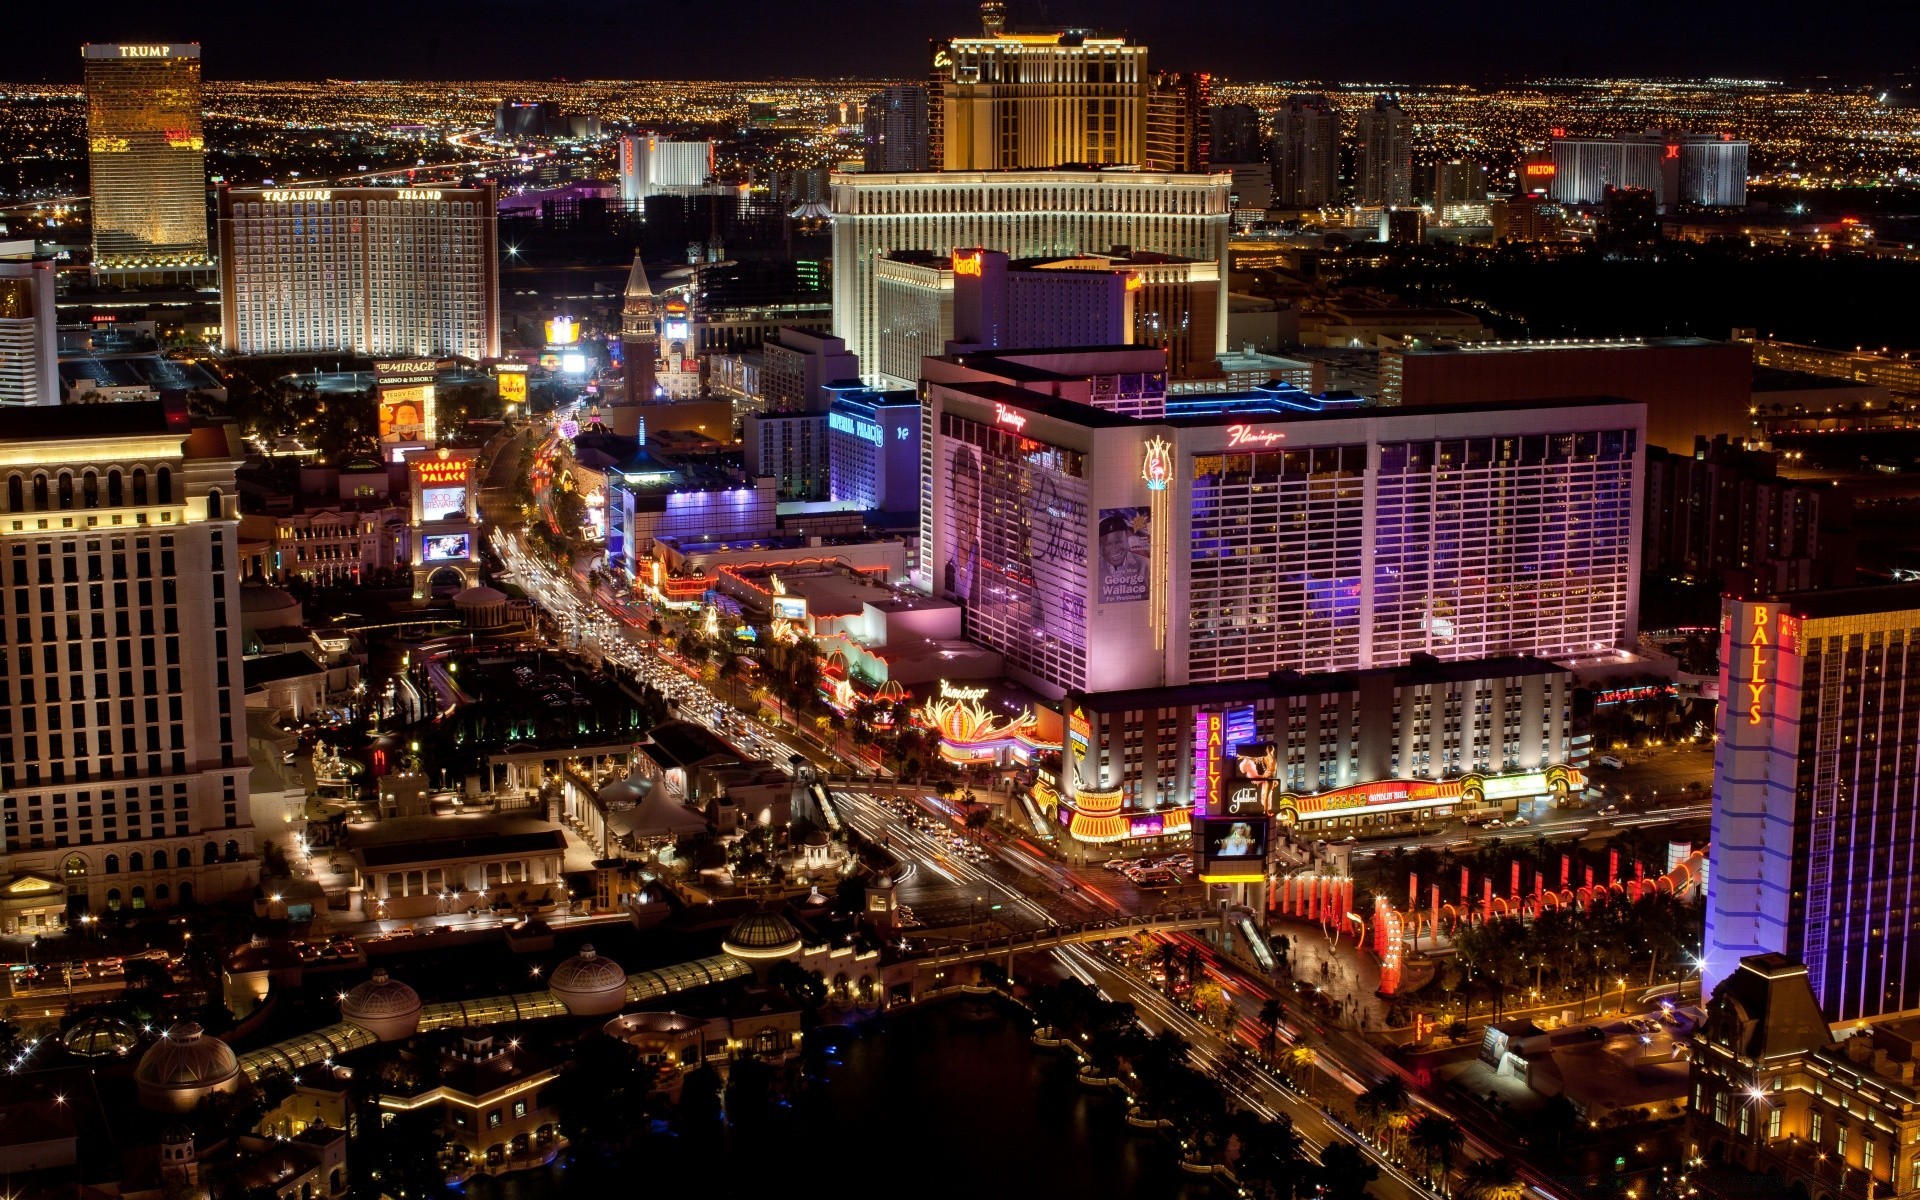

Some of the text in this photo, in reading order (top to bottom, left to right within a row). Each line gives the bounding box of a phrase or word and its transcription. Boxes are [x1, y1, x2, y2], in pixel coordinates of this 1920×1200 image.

[119, 46, 170, 57] TRUMP
[1527, 165, 1555, 175] HILTON
[262, 190, 442, 201] TREASURE ISLAND
[389, 361, 435, 373] MIRAGE
[995, 403, 1027, 432] Flamingo
[829, 412, 854, 435] IMPERIAL
[1226, 424, 1285, 447] Flamingo
[419, 462, 467, 472] CAESARS
[422, 472, 466, 482] PALACE
[430, 493, 451, 503] ROD
[424, 500, 457, 509] STEWART
[1104, 574, 1145, 585] George
[1102, 585, 1146, 596] Wallace
